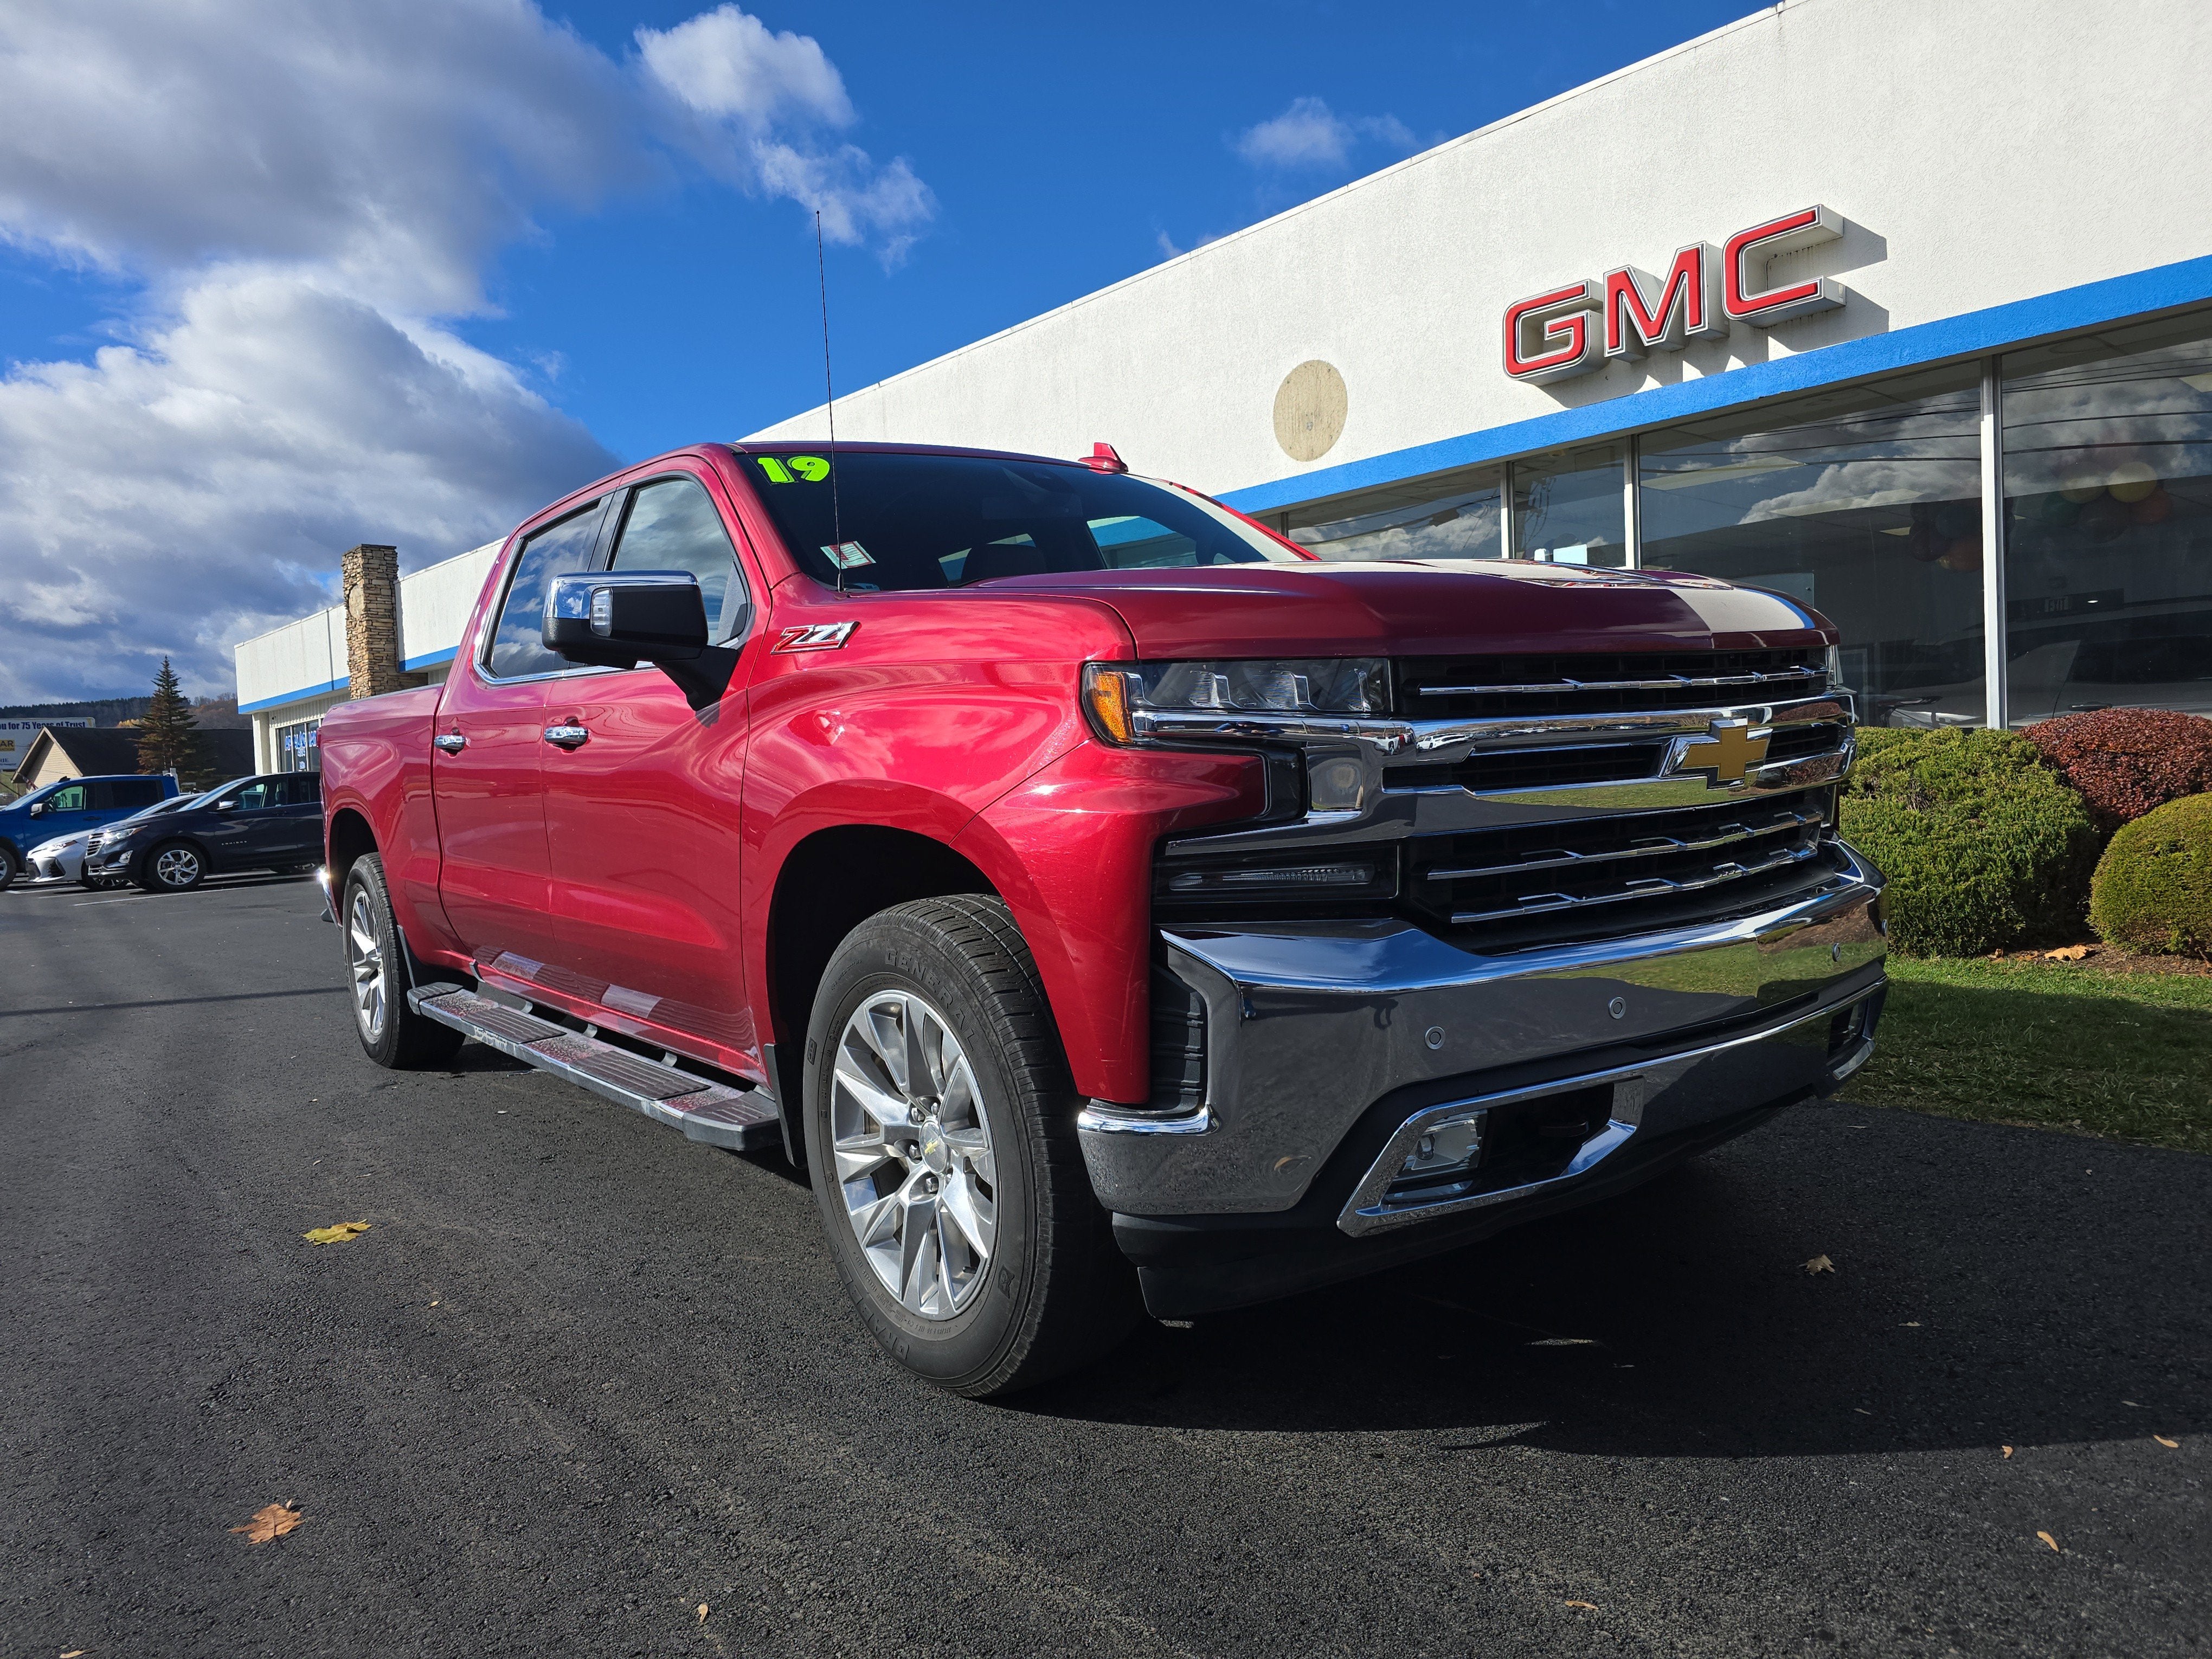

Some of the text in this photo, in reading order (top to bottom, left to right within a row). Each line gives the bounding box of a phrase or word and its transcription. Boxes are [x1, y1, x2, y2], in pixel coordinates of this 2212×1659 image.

[1502, 204, 1825, 382] GMC
[757, 456, 830, 483] 19
[770, 621, 860, 655] Z71
[885, 949, 975, 1052] GENERAL
